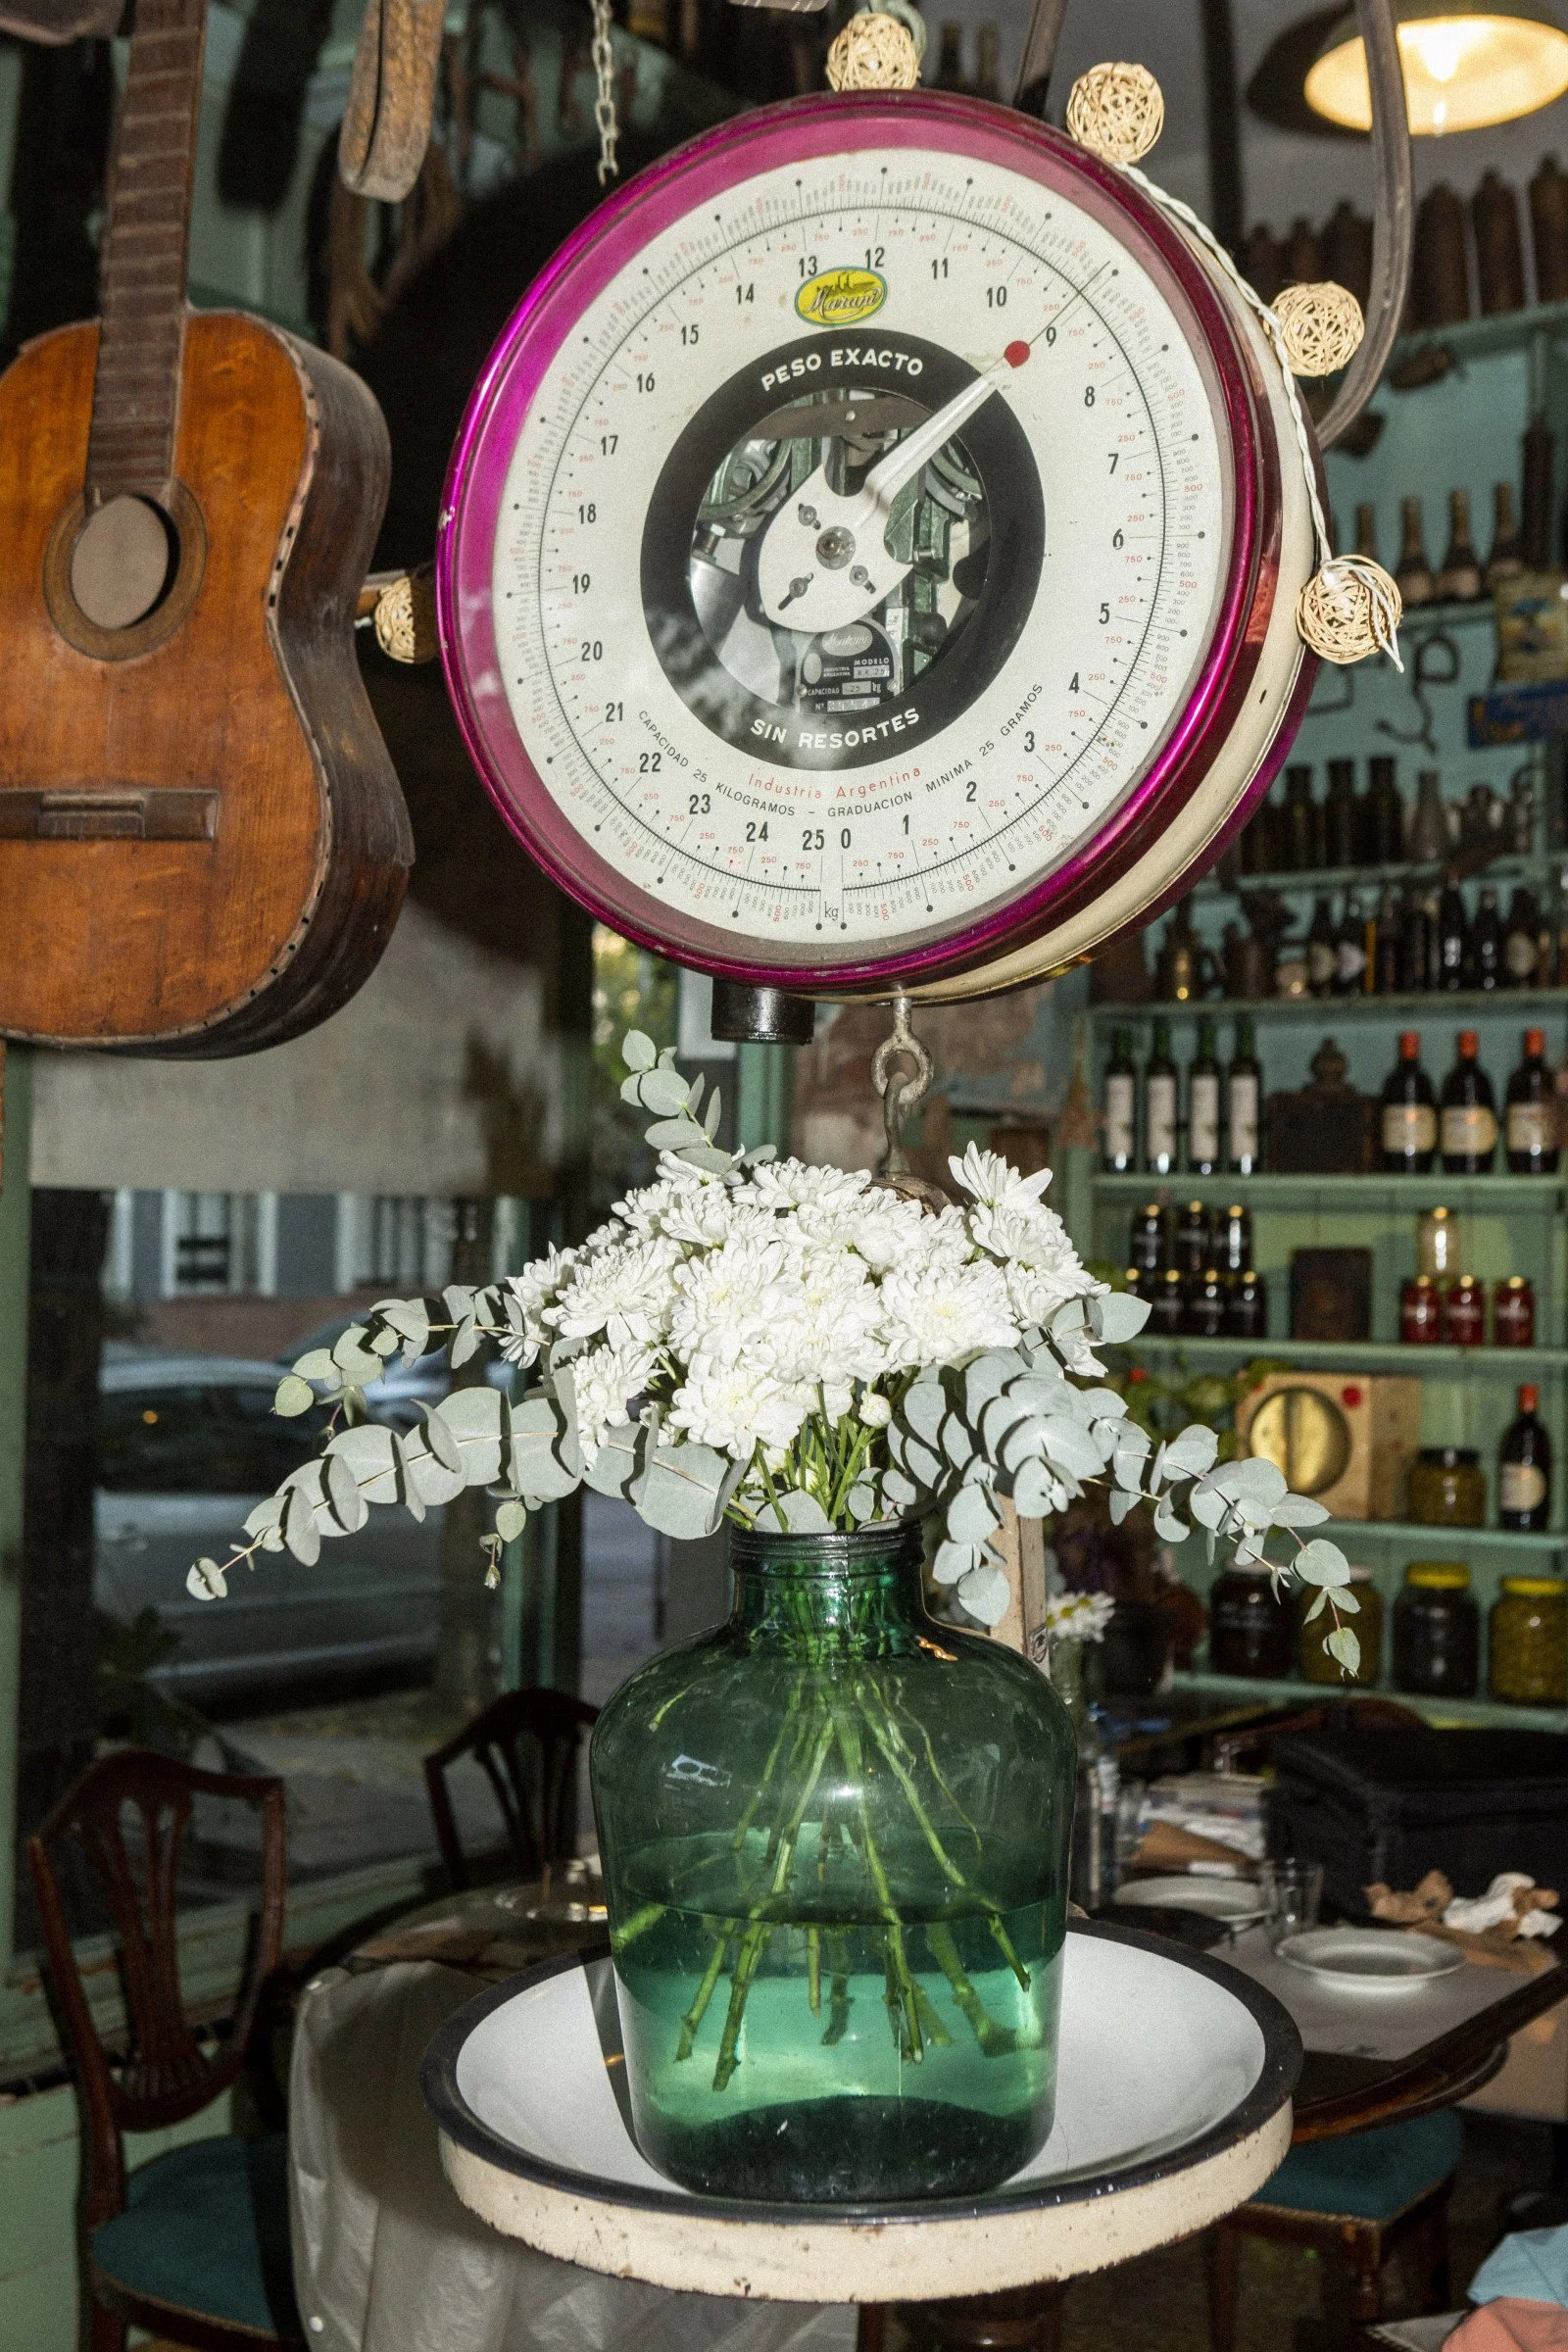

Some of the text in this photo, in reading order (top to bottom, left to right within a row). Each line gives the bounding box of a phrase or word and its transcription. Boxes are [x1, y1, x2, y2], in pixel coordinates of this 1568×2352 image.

[799, 257, 817, 276] 13
[864, 247, 885, 269] 12
[931, 258, 949, 279] 11
[736, 284, 755, 304] 14
[986, 286, 1007, 308] 10
[681, 324, 699, 345] 15
[1046, 326, 1056, 347] 9
[760, 349, 923, 391] PESO EXACTO
[637, 372, 655, 393] 16
[1084, 386, 1095, 408] 8
[1168, 389, 1185, 400] 500
[601, 435, 618, 456] 17
[1107, 453, 1119, 474] 7
[578, 504, 596, 524] 18
[1112, 528, 1123, 550] 6
[572, 574, 590, 594] 19
[1099, 603, 1109, 624] 5
[1157, 633, 1169, 642] 900
[581, 641, 603, 662] 20
[1150, 672, 1167, 684] 500
[1153, 663, 1167, 672] 600
[1068, 672, 1079, 693] 4
[606, 702, 623, 722] 21
[751, 708, 919, 749] SIN RESORTES
[639, 710, 689, 767] CAPACIDAD
[693, 768, 708, 783] 25
[715, 782, 795, 815] KILOGRAMOS
[827, 792, 913, 817] GRADUACION
[925, 760, 973, 793] MINIMA
[979, 741, 995, 757] 25
[1000, 684, 1043, 737] GRAMOS
[1024, 731, 1035, 753] 3
[639, 753, 662, 773] 22
[1102, 756, 1118, 771] 500
[749, 767, 921, 799] Industria Argentina
[966, 781, 977, 802] 2
[689, 794, 711, 815] 23
[746, 821, 769, 843] 24
[904, 814, 909, 835] 1
[1038, 825, 1053, 842] 500
[803, 829, 825, 851] 25
[841, 828, 851, 849] 0
[694, 883, 705, 900] 500
[963, 874, 974, 892] 500
[824, 902, 839, 921] kg
